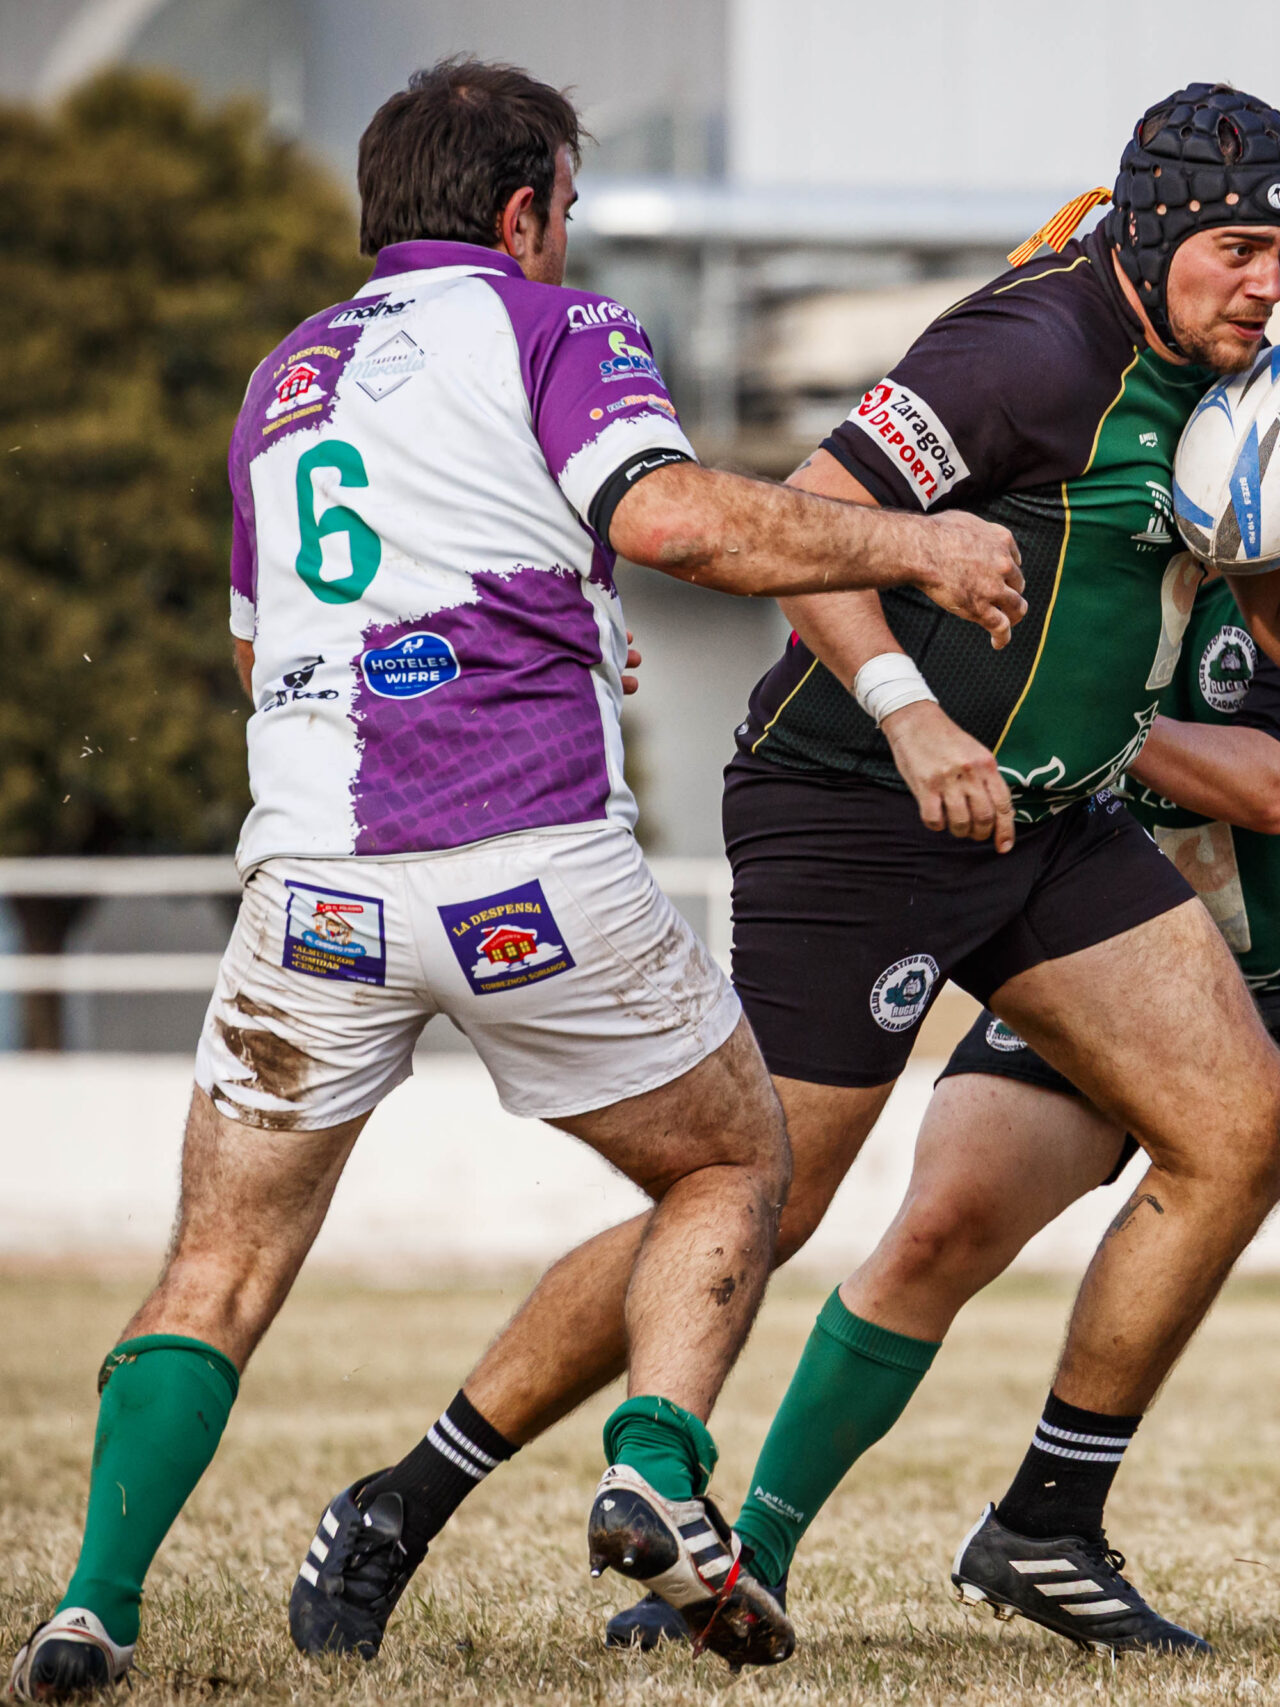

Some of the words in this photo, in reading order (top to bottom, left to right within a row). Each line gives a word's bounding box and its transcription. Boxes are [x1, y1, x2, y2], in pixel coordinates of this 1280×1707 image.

[890, 393, 956, 481] Zaragoza
[296, 440, 382, 605] 6
[371, 657, 449, 671] HOTELES
[384, 670, 440, 684] WIFRE
[452, 921, 471, 937] LA
[470, 902, 542, 926] DESPENSA
[871, 991, 881, 1014] CLUB
